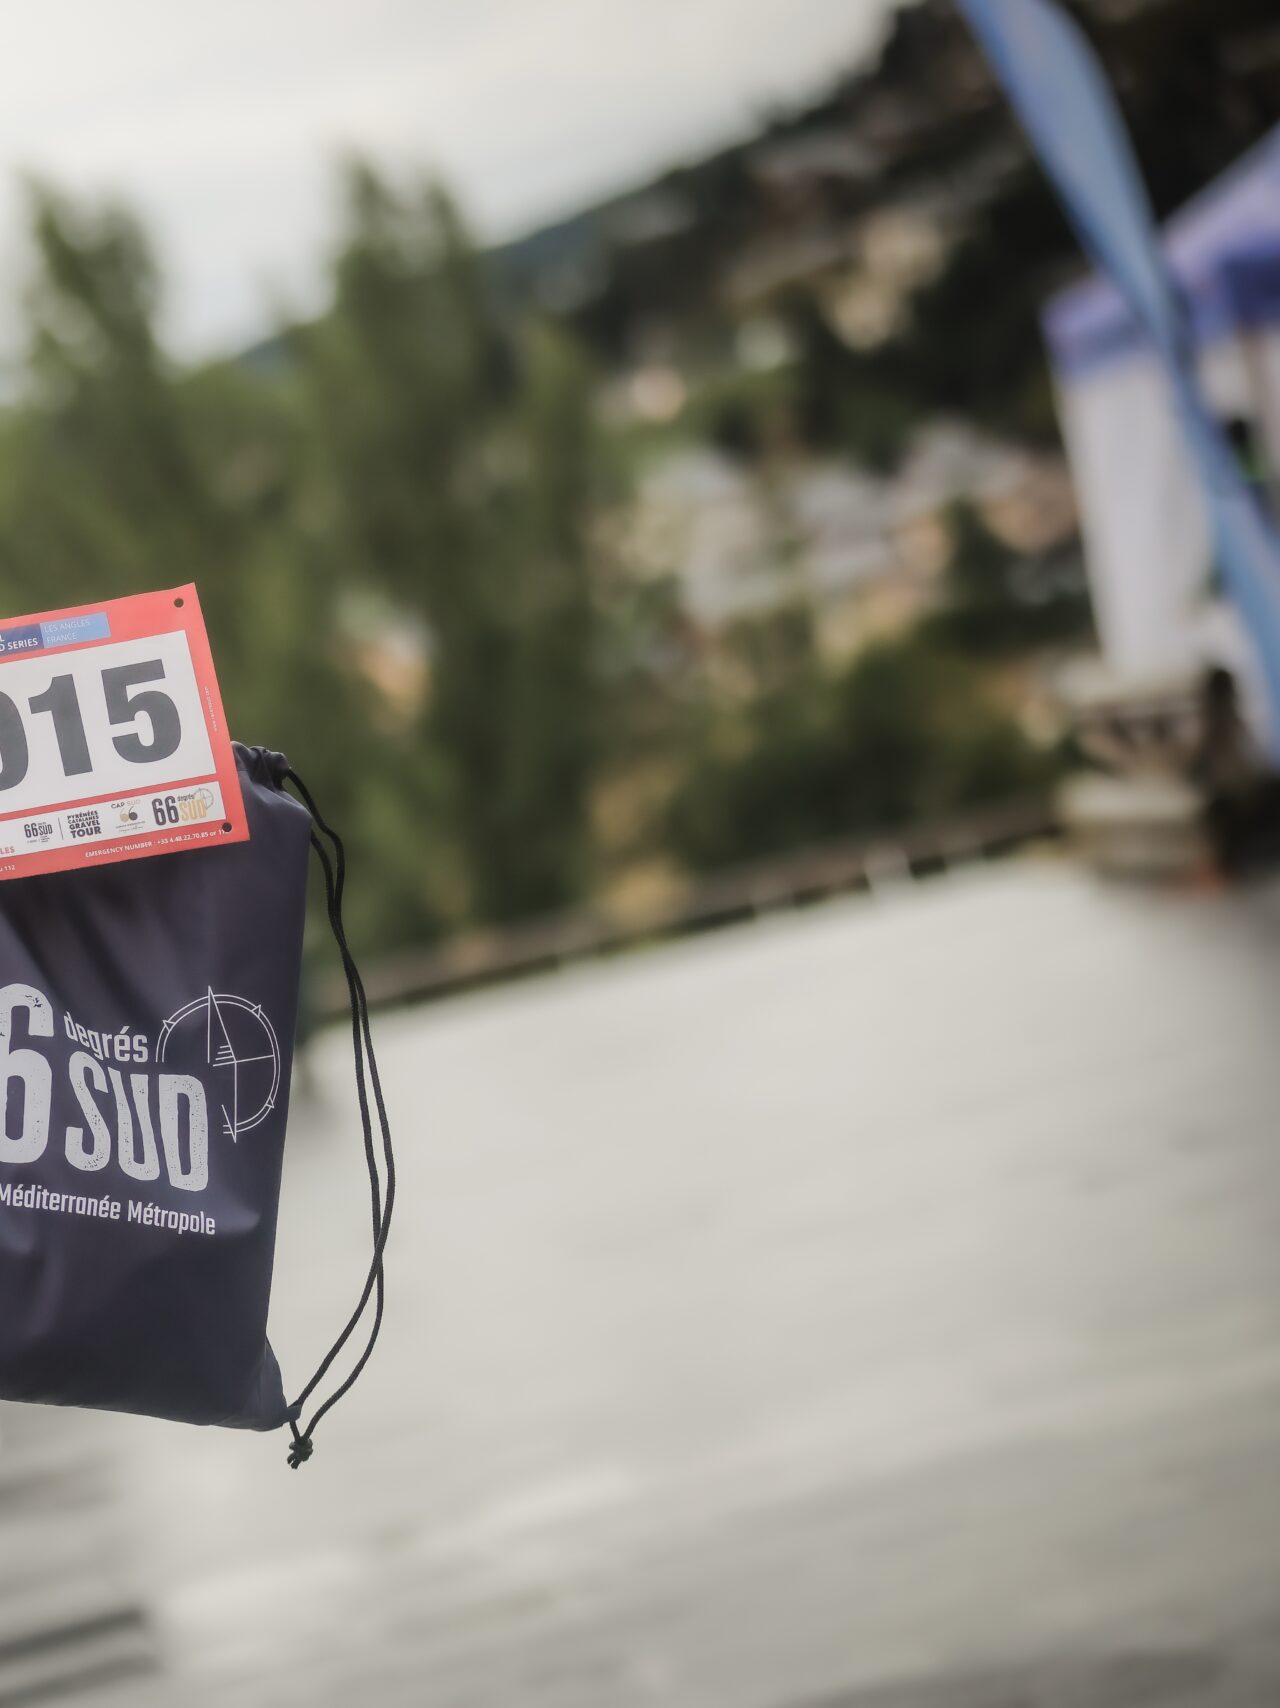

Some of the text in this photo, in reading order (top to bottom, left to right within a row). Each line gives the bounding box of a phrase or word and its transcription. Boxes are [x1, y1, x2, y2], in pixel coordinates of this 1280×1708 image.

[44, 618, 91, 633] LES ANGLES
[7, 637, 39, 650] SERIES
[46, 632, 78, 644] FRANCE
[151, 795, 207, 826] 66 SUD
[24, 822, 53, 838] 66 SUD
[69, 820, 101, 830] GRAVEL
[70, 826, 102, 839] TOUR
[85, 846, 123, 858] EMERGENCY
[124, 842, 153, 852] NUMBER
[4, 864, 16, 872] 112
[63, 1011, 148, 1064] degrés
[64, 1050, 209, 1192] SUD
[127, 1199, 216, 1236] Métropole
